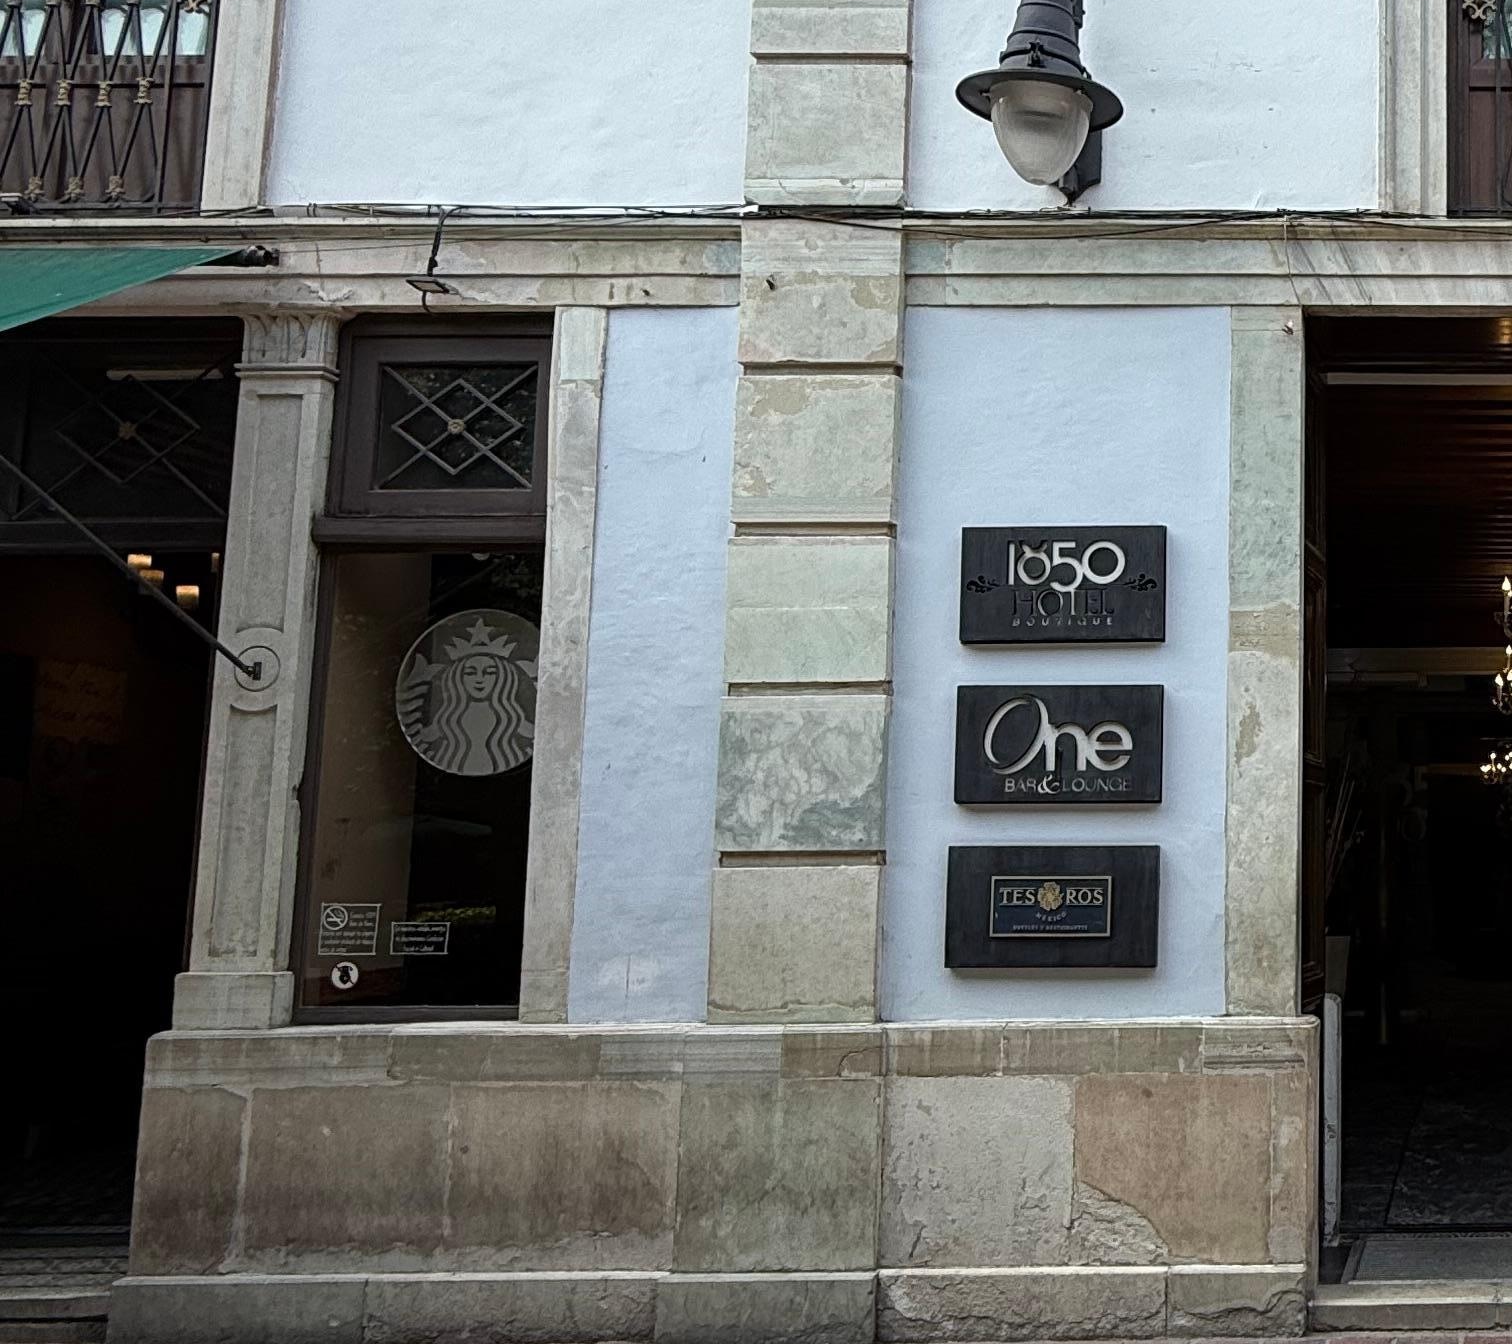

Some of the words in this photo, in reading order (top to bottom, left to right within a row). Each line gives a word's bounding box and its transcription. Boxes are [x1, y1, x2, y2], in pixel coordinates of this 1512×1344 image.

[1007, 540, 1126, 593] 1850
[1011, 616, 1113, 627] BOUTIQUE
[1013, 589, 1115, 617] HOTEL
[983, 693, 1134, 775] One
